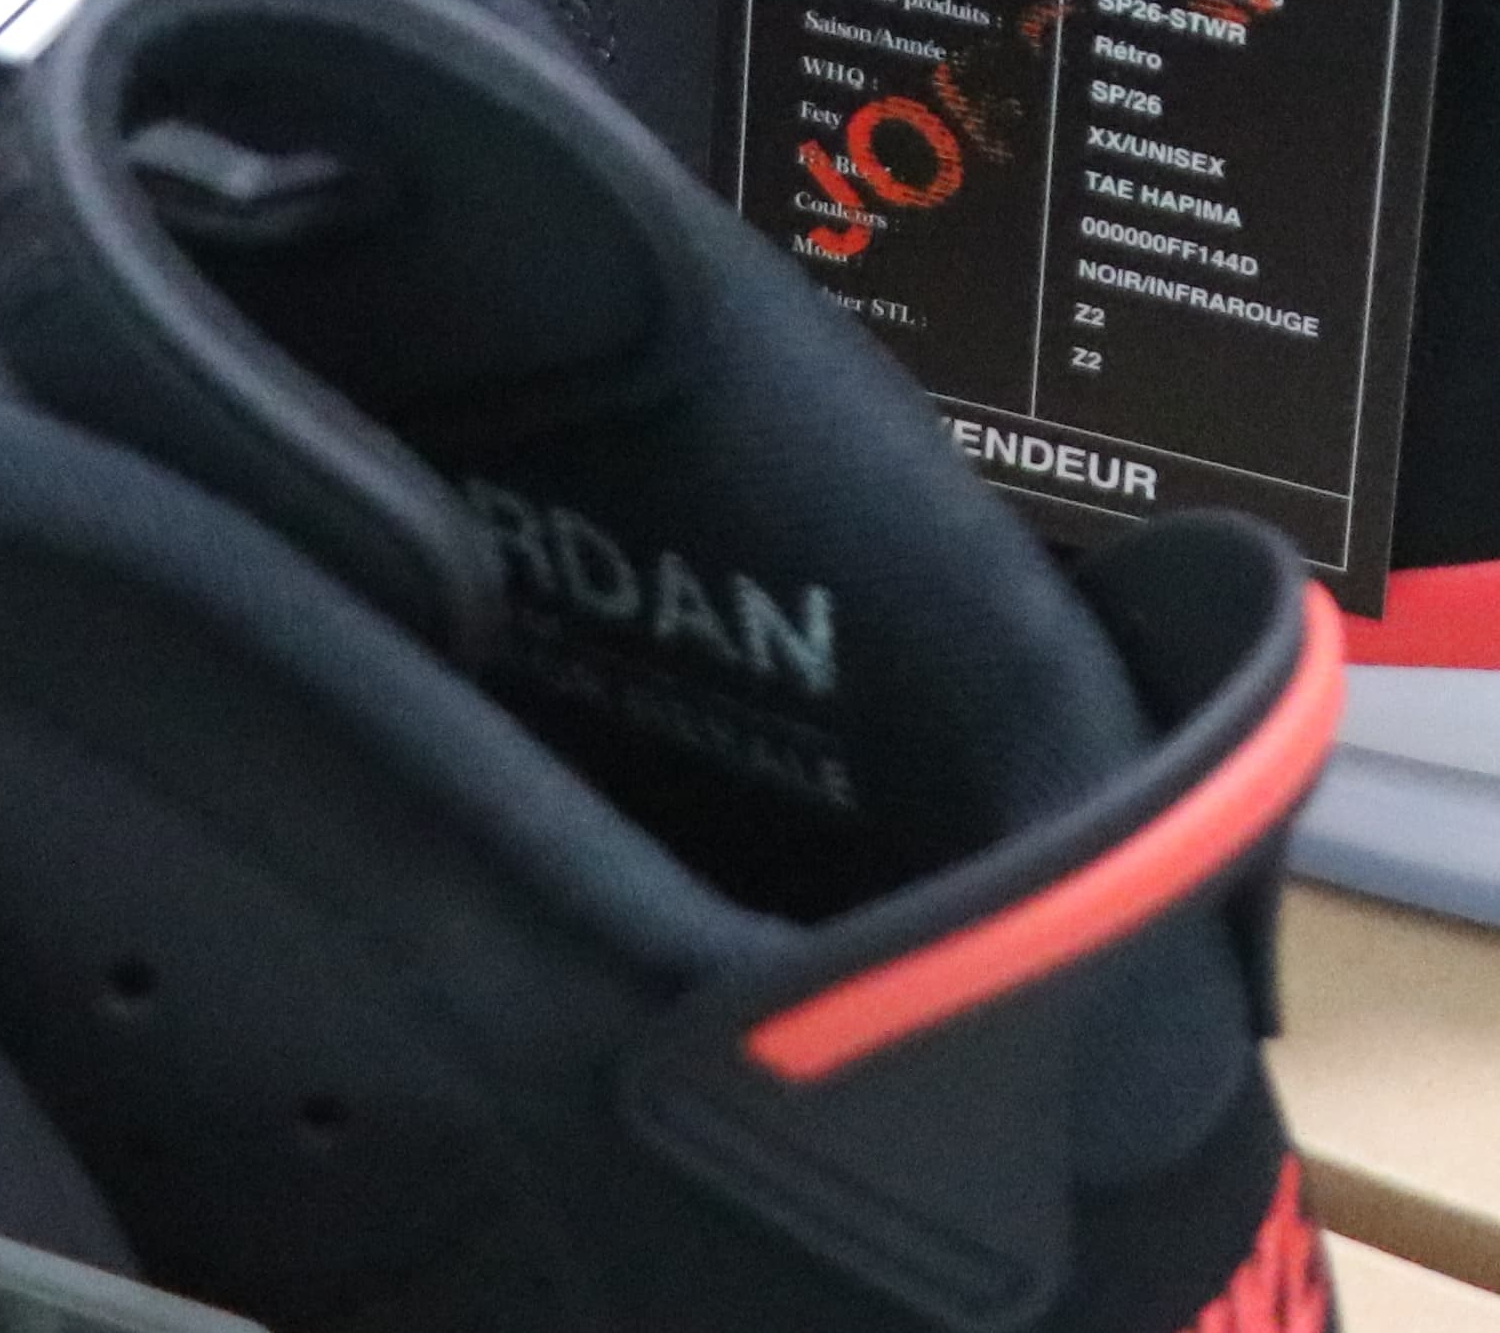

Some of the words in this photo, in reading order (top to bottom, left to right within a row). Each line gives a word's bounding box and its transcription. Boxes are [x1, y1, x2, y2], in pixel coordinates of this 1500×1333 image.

[804, 10, 947, 60] Saison/Année
[1094, 34, 1162, 70] Rétro
[802, 56, 865, 90] WHQ
[1091, 80, 1163, 116] SP/26
[1086, 125, 1227, 179] XX/UNISEX
[1084, 170, 1135, 201] TAE
[1141, 184, 1243, 228] HAPIMA
[1081, 216, 1260, 277] 000000FF144D
[870, 298, 915, 326] STL
[1073, 302, 1106, 327] Z2
[1077, 259, 1320, 337] NOIR/INFRAROUGE
[1071, 346, 1103, 371] Z2
[943, 416, 1158, 501] ENDEUR
